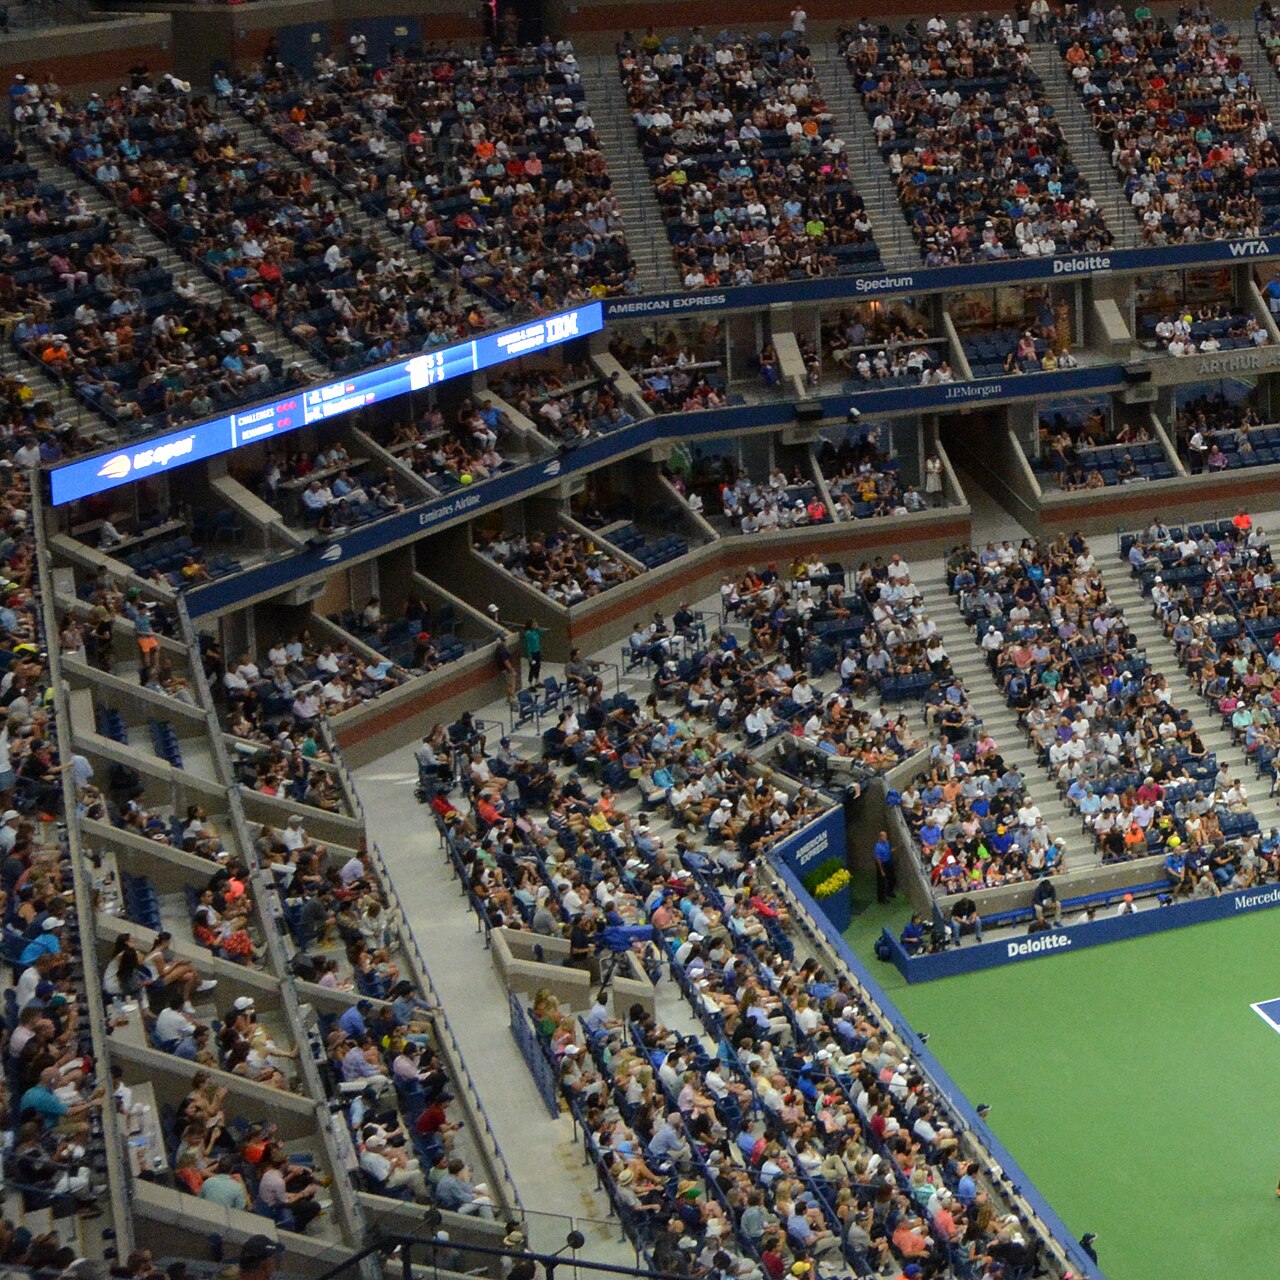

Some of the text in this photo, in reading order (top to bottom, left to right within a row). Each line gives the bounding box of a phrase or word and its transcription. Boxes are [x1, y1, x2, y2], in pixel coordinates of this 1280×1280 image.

[1229, 241, 1269, 256] WTA
[1053, 256, 1111, 274] Deloitte
[855, 276, 913, 292] Spectrum
[608, 294, 726, 314] AMERICAN EXPRESS
[546, 312, 578, 343] IBM
[1199, 355, 1260, 374] ARTHUR
[945, 385, 1003, 399] J.P.Morgan
[420, 494, 480, 525] Emirates Airline
[795, 830, 828, 860] AMERICAN
[800, 839, 829, 866] EXPRESS
[1007, 934, 1072, 958] Deloitte.
